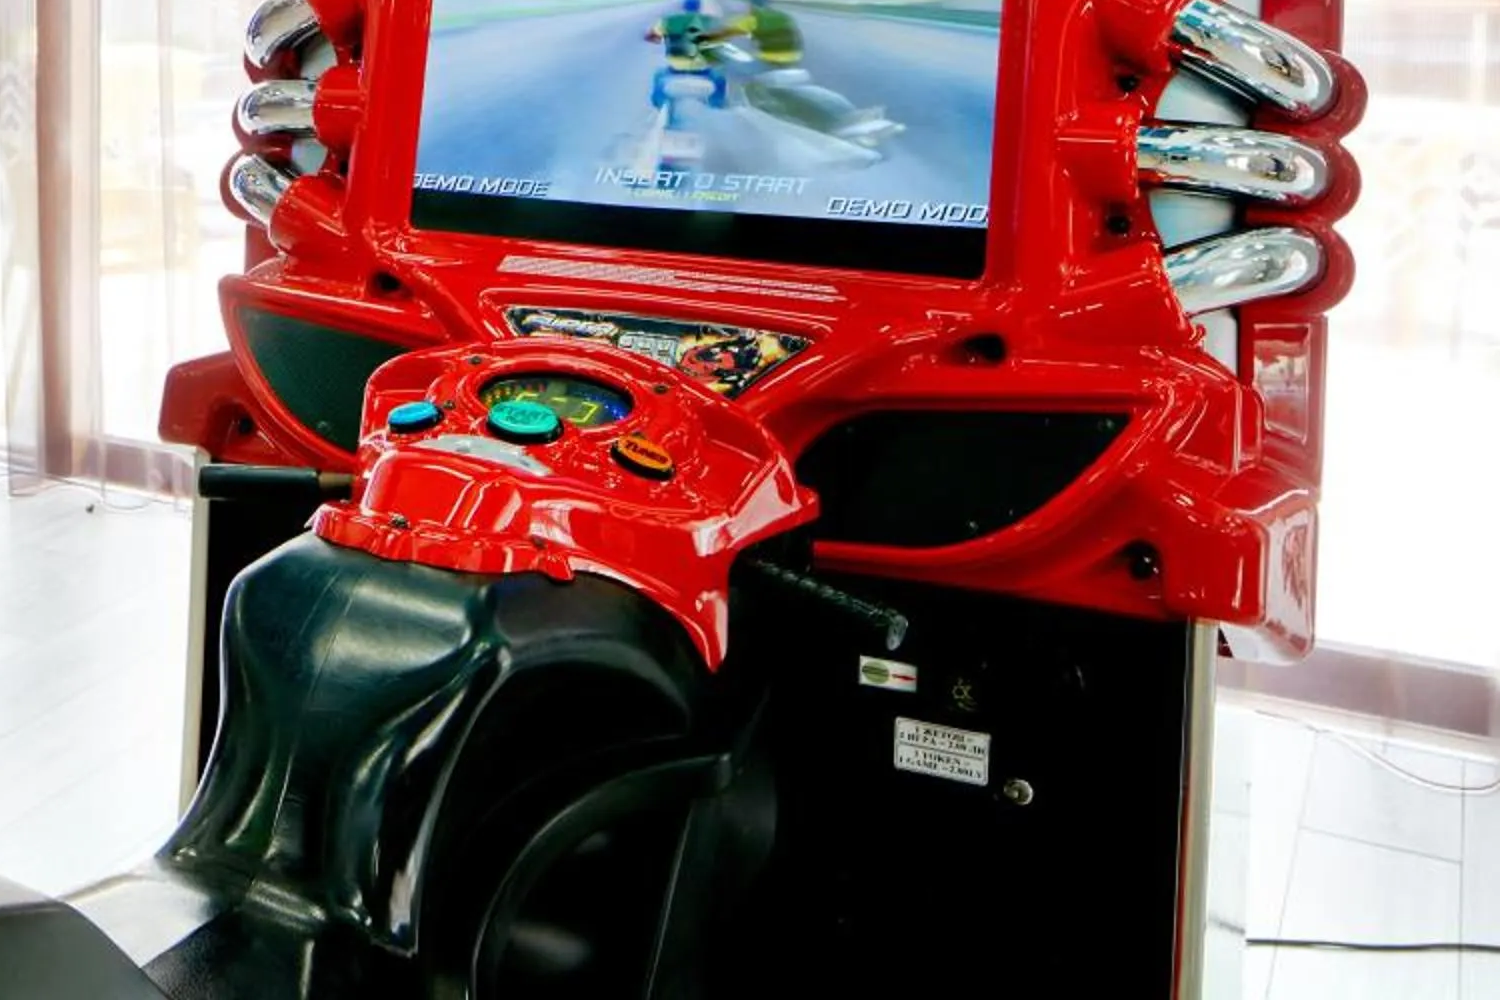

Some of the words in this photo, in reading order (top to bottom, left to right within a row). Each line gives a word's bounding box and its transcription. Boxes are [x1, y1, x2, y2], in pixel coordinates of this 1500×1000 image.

[477, 177, 550, 197] MODE
[595, 167, 689, 190] INSERT
[723, 175, 813, 194] START
[827, 197, 912, 219] DEMO
[919, 200, 988, 223] MOD
